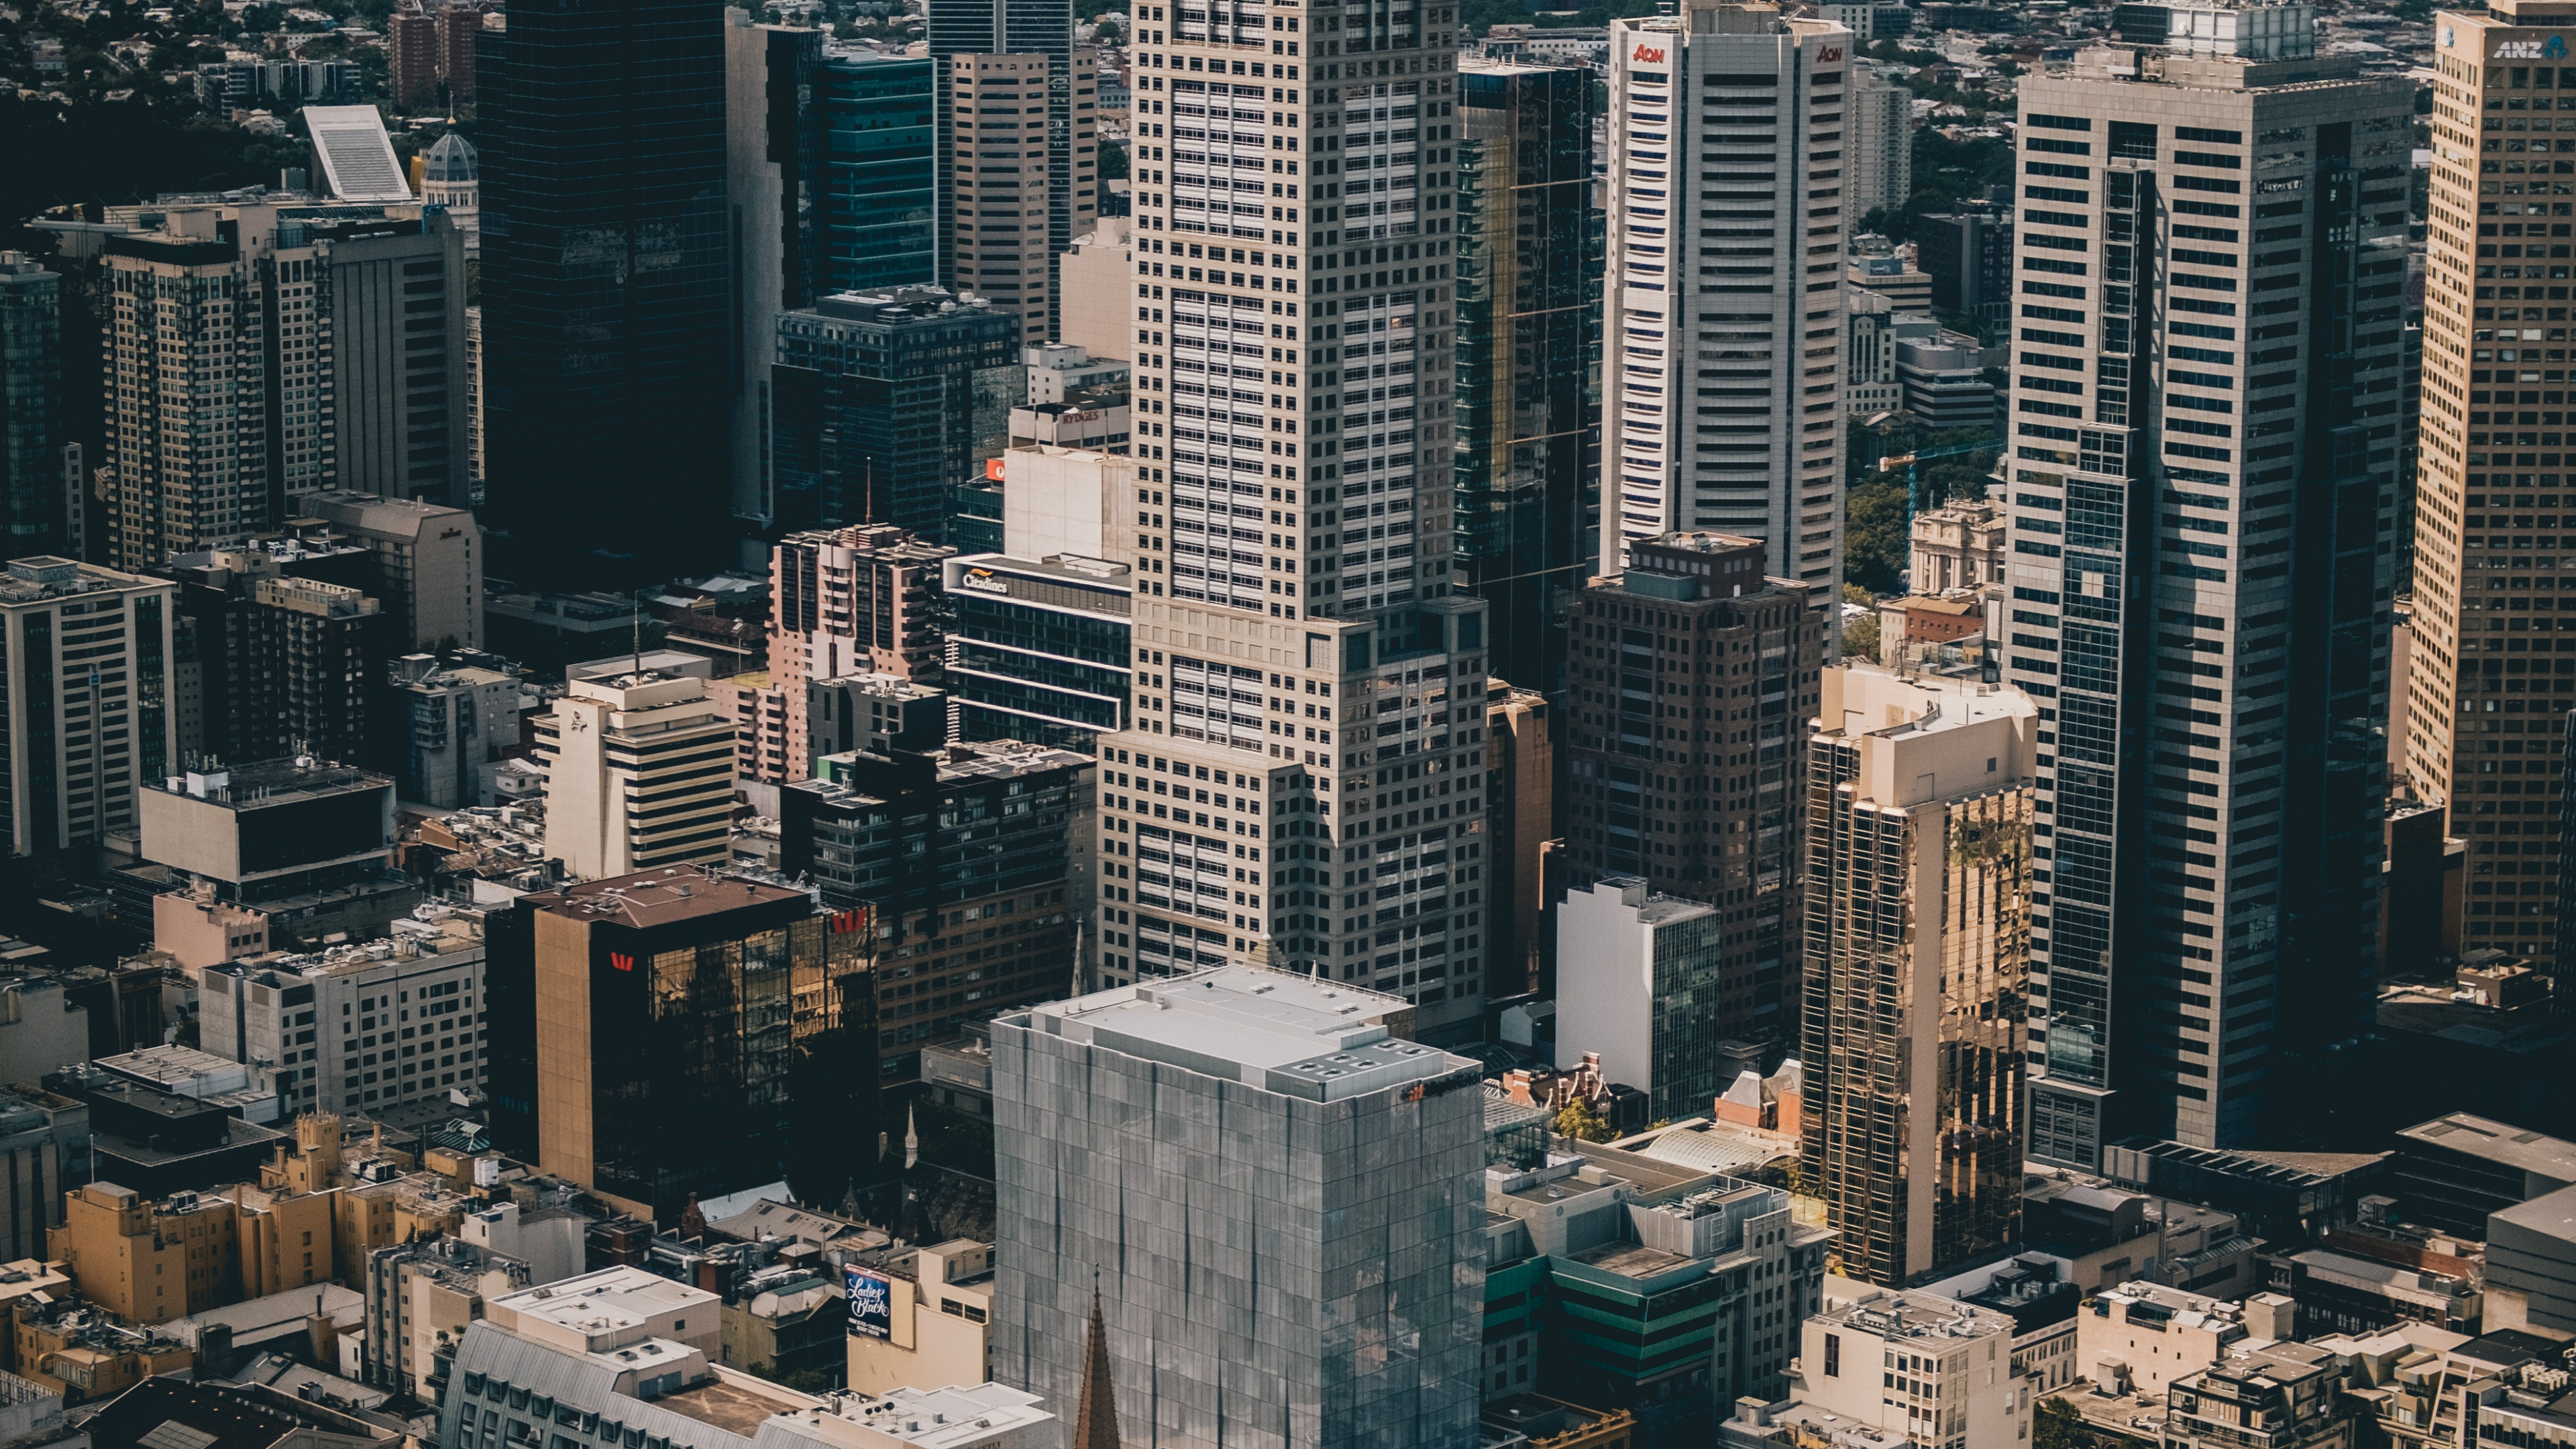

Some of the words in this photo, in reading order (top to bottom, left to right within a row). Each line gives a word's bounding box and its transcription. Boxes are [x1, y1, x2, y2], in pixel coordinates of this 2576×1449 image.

[2493, 41, 2542, 58] ANZ
[1063, 411, 1099, 425] RYDGES
[963, 574, 1008, 594] Citadines
[847, 1277, 885, 1303] Ladies
[851, 1297, 890, 1317] Black
